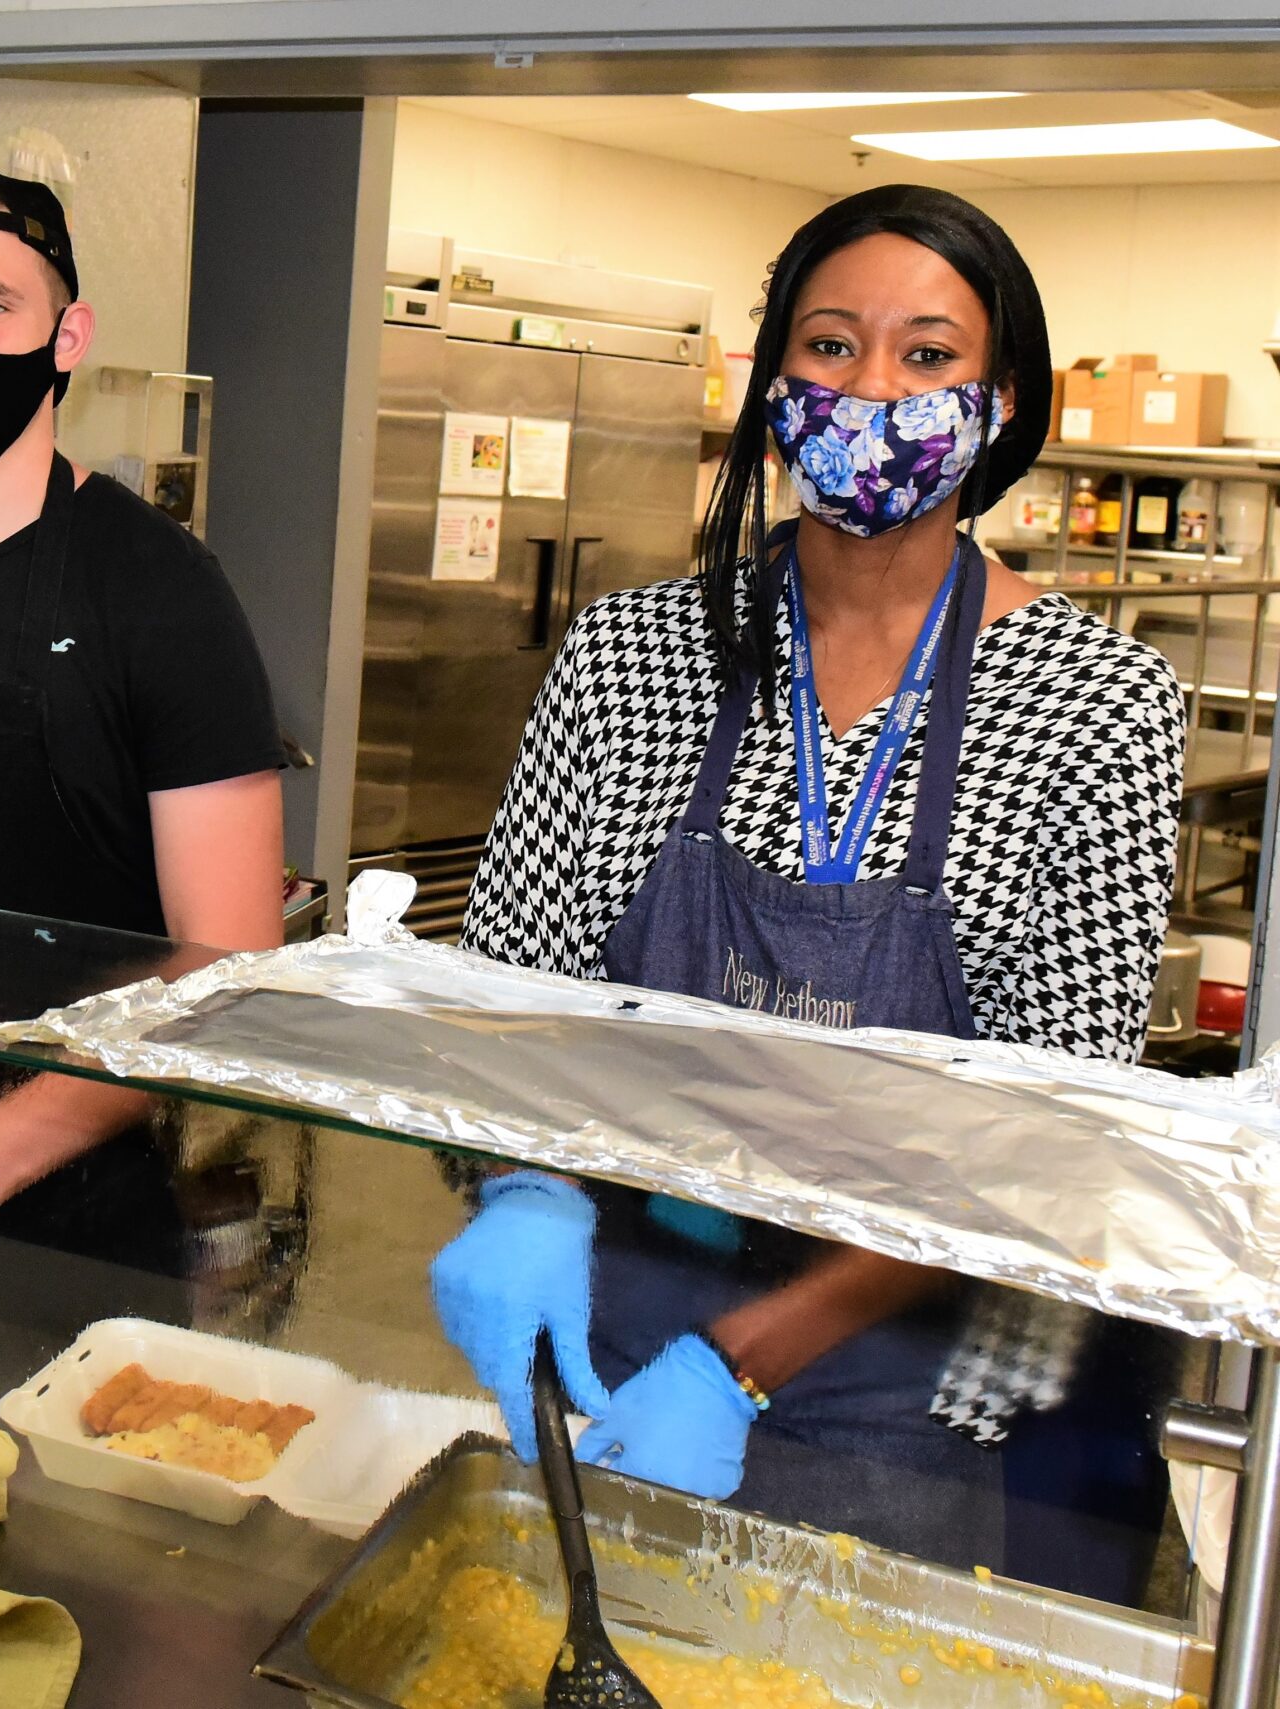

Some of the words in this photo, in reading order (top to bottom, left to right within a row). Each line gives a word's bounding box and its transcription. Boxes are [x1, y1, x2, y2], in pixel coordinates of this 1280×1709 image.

[800, 688, 817, 805] www.accuratetemps.com
[844, 747, 895, 865] www.accuratetemps.com
[722, 946, 769, 1011] New
